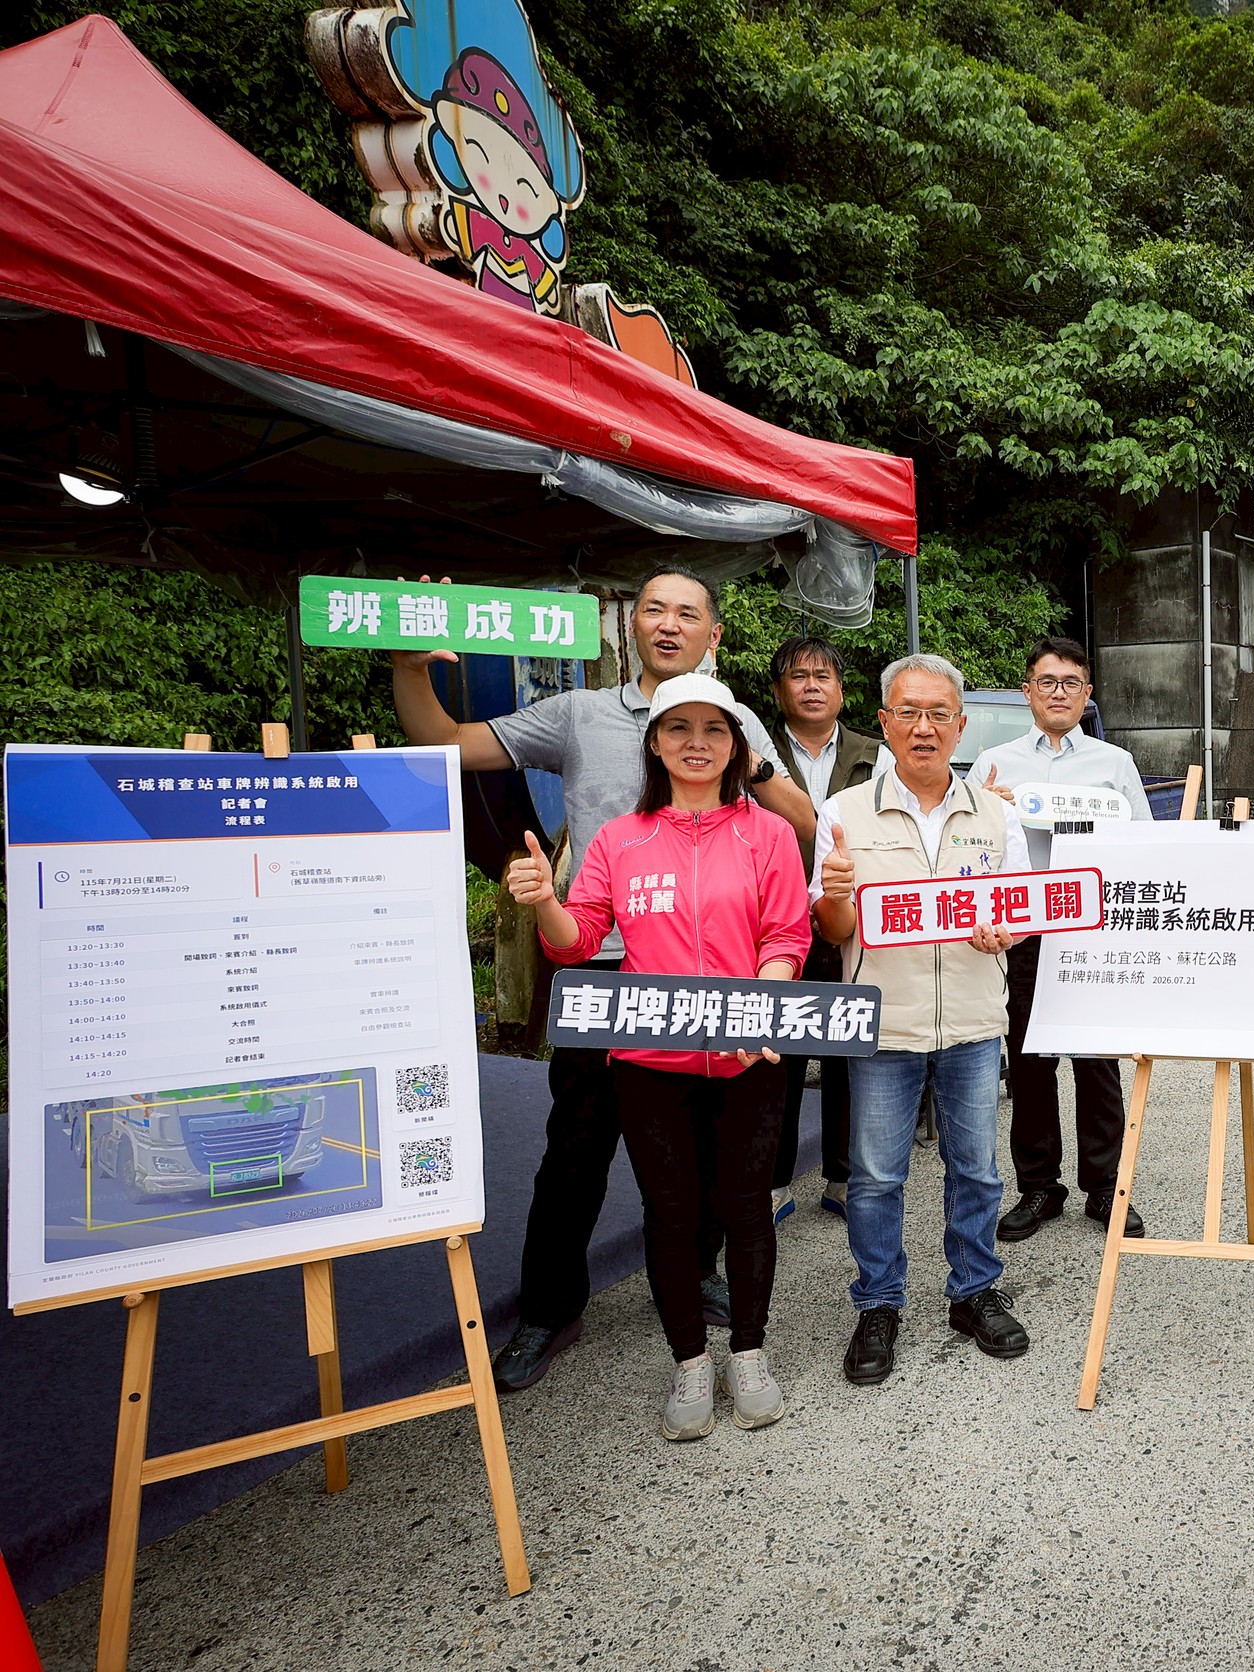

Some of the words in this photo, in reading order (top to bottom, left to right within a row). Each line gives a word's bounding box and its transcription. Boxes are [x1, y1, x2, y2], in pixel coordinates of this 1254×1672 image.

[328, 589, 576, 646] 辨識成功
[117, 776, 359, 792] 石城稽查站車牌辨識系統啟用
[220, 797, 268, 810] 記者會
[1051, 795, 1120, 811] 中華電信
[224, 815, 266, 826] 流程表
[1091, 810, 1120, 819] Telecom
[629, 873, 676, 892] 縣議員
[627, 890, 675, 917] 林麗
[880, 881, 1082, 935] 嚴格把關
[1058, 950, 1238, 967] 石城、北宜公路、蘇花公路
[225, 967, 258, 976] 系統介紹
[1056, 969, 1146, 985] 車牌辨識系統
[1152, 975, 1196, 986] 2026.07.21
[556, 984, 876, 1043] 車牌辨識系統
[231, 1019, 256, 1028] 大合照
[227, 1036, 260, 1046] 交流時間
[225, 1053, 266, 1064] 記者會結束
[86, 1069, 112, 1079] 14:20
